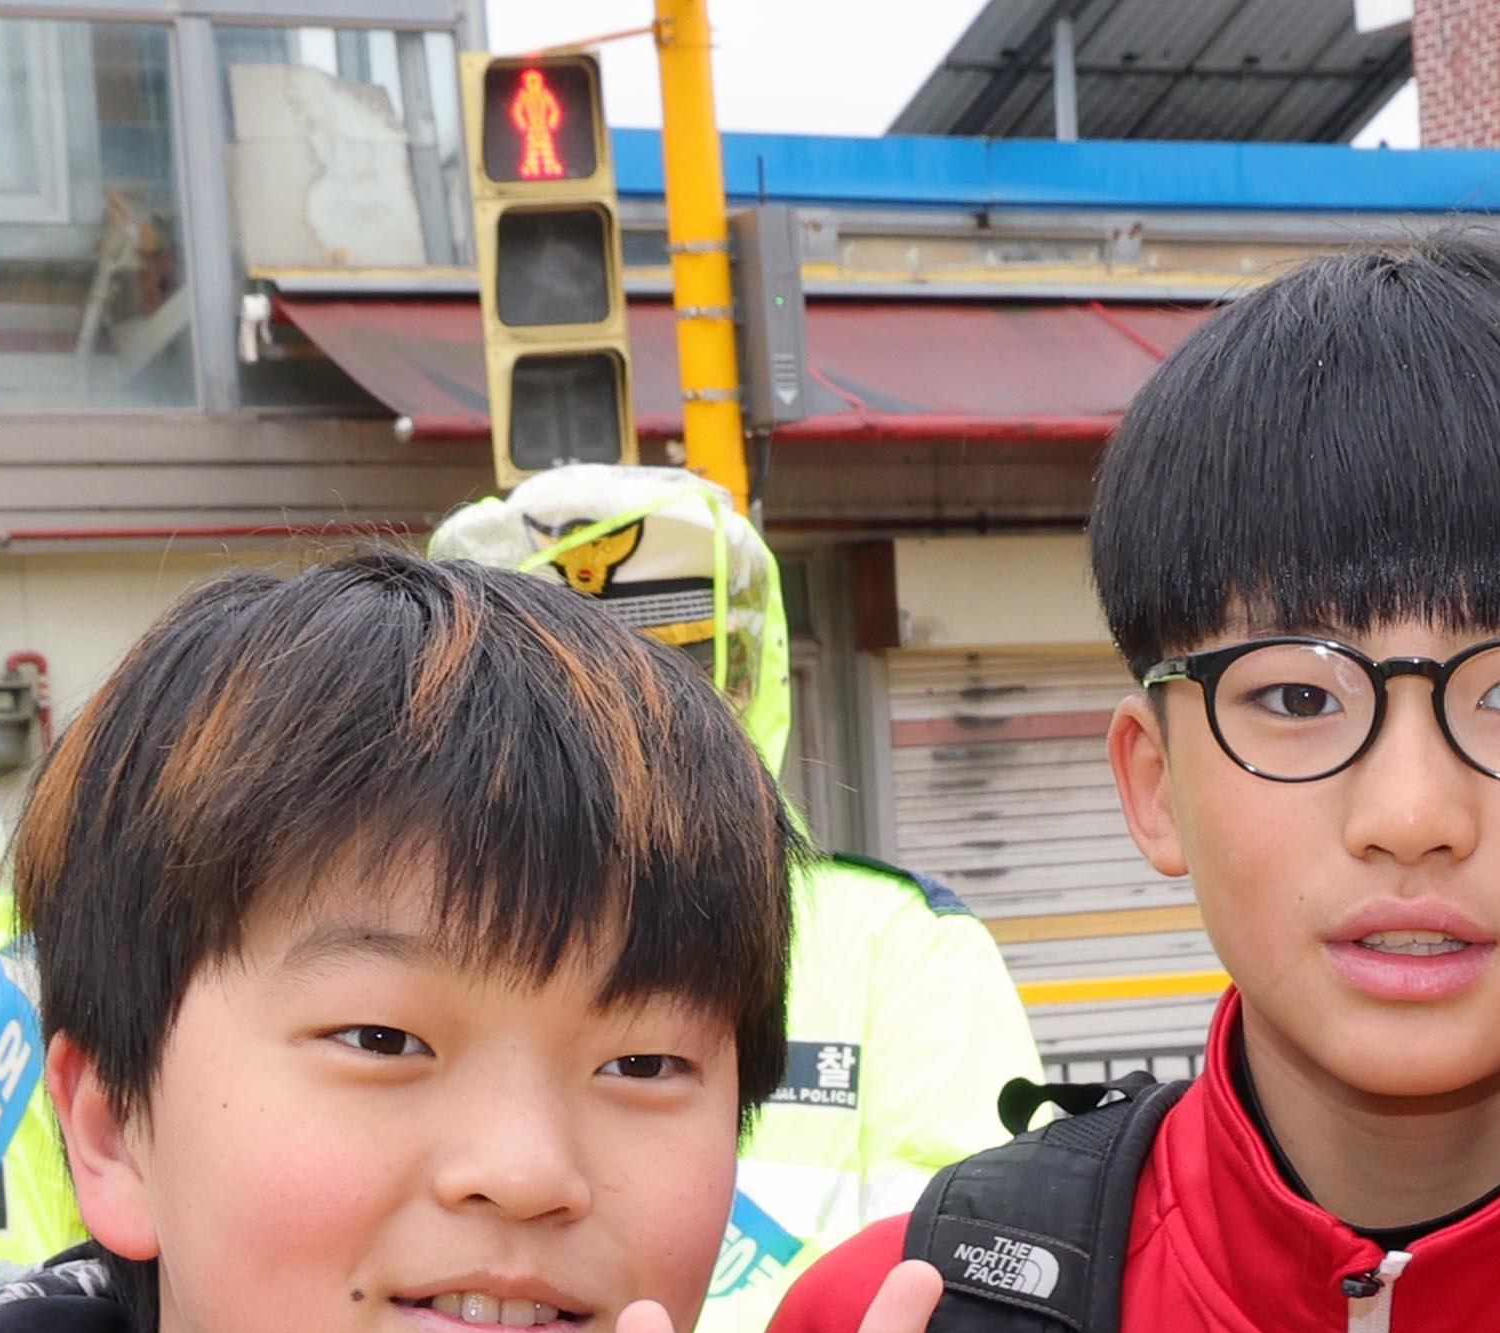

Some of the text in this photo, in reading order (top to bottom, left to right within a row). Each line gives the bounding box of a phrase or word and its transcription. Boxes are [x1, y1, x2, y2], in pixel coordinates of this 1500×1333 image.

[801, 1088, 857, 1106] POLICE
[953, 1243, 1025, 1275] NORTH
[993, 1236, 1031, 1259] THE
[963, 1262, 1018, 1291] FACE
